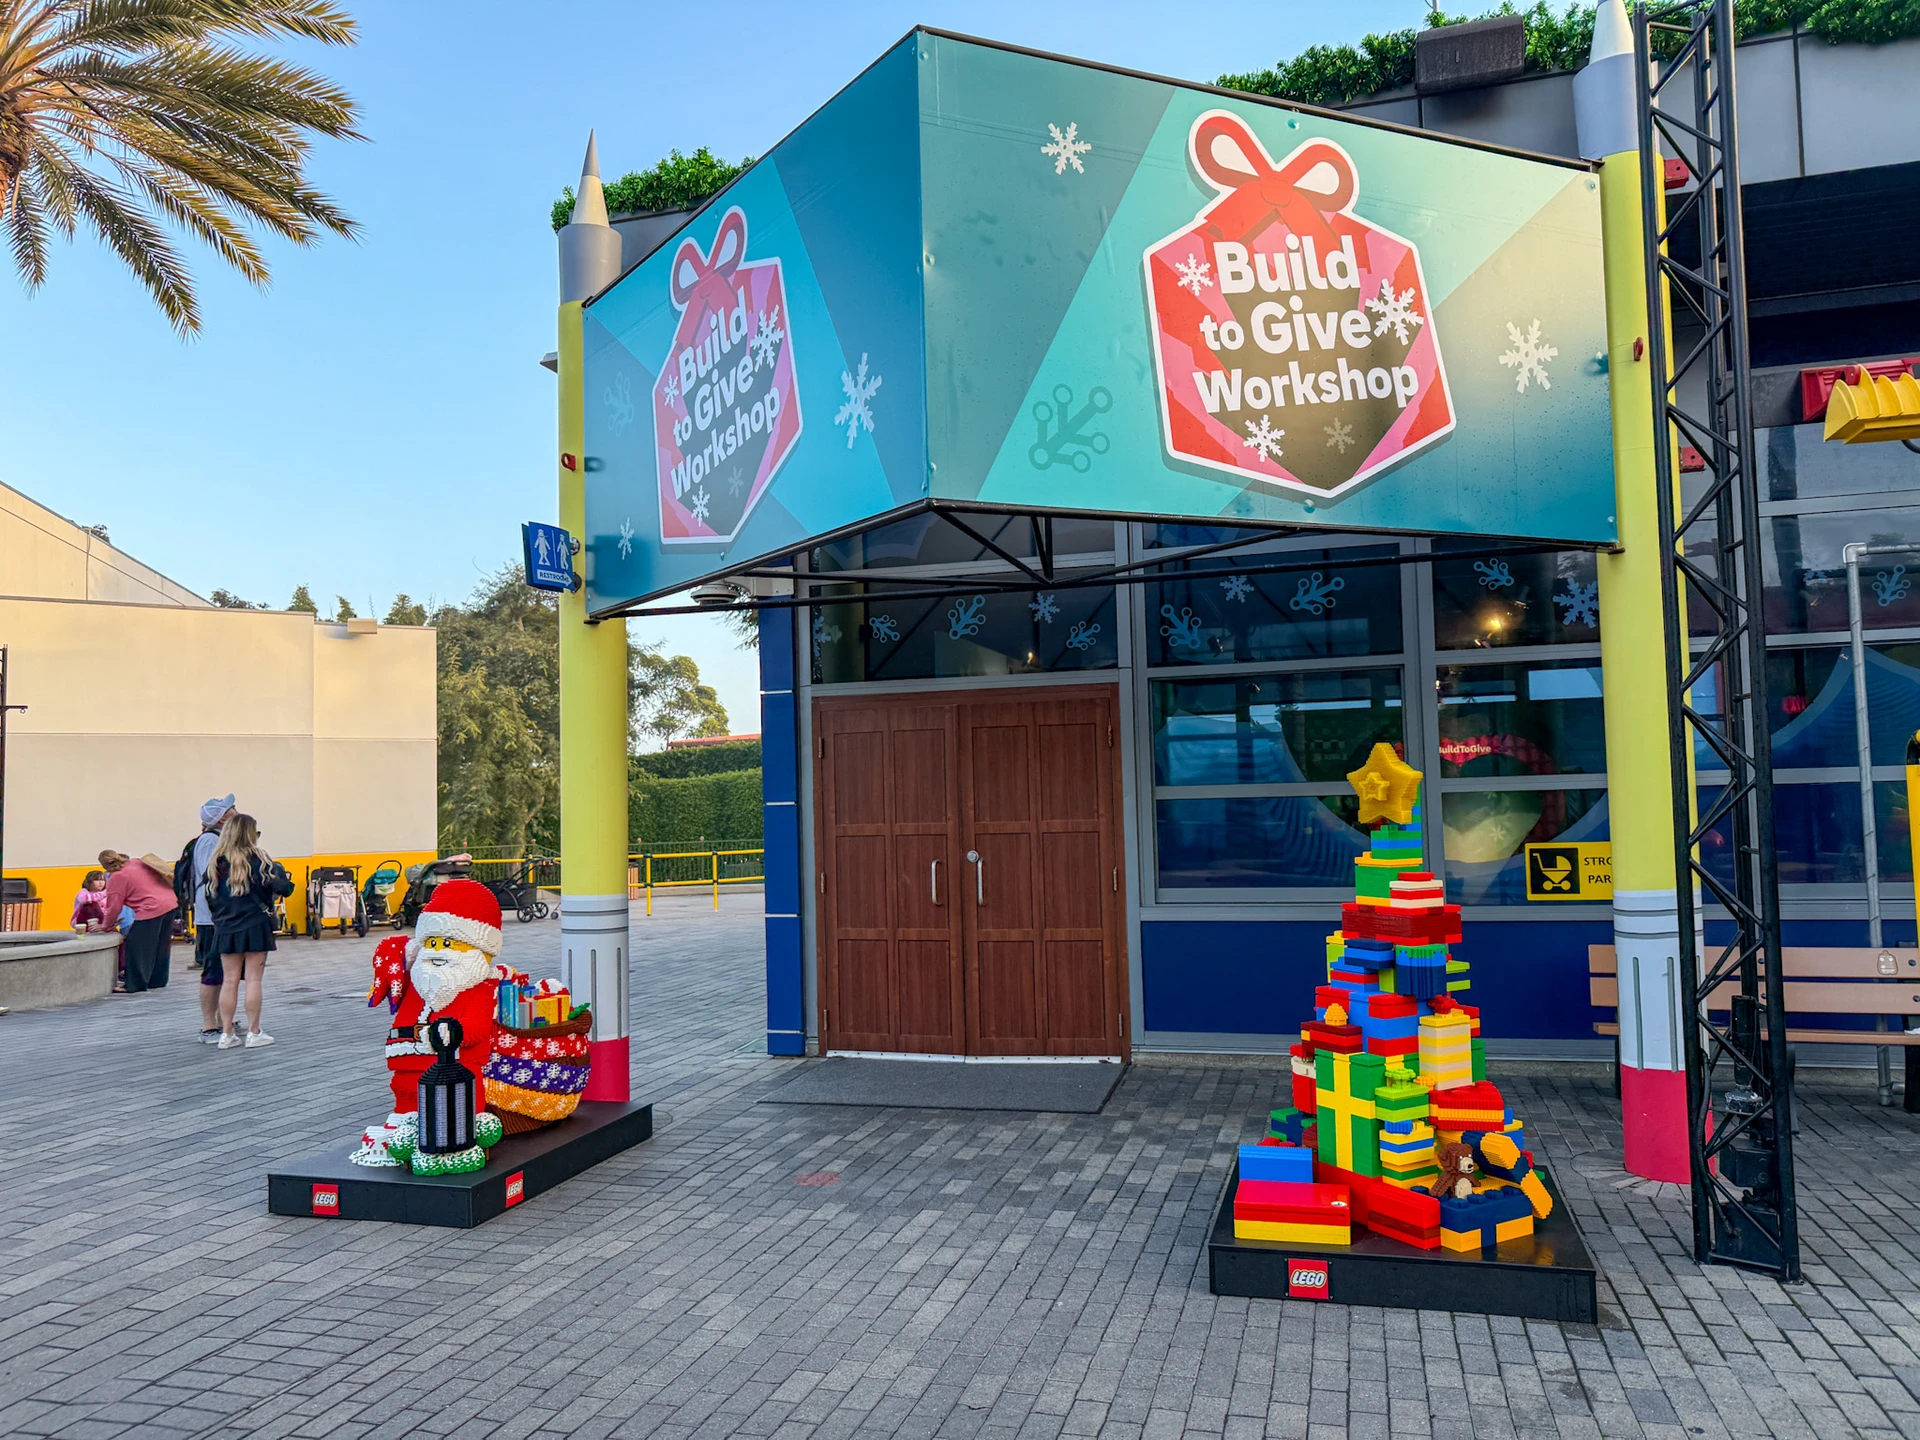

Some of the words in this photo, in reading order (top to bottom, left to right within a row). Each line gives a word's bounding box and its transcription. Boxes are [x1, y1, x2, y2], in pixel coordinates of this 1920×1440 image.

[1213, 233, 1361, 294] Build
[679, 285, 749, 396] Build
[1199, 314, 1245, 351] to
[1250, 295, 1372, 354] Give
[673, 415, 692, 447] to
[694, 355, 755, 431] Give
[1192, 357, 1419, 413] Workshop
[670, 386, 781, 501] Workshop
[1588, 874, 1612, 884] PAR
[314, 1193, 337, 1206] LEGO
[507, 1181, 522, 1197] LEGO
[1291, 1270, 1326, 1287] LEGO
